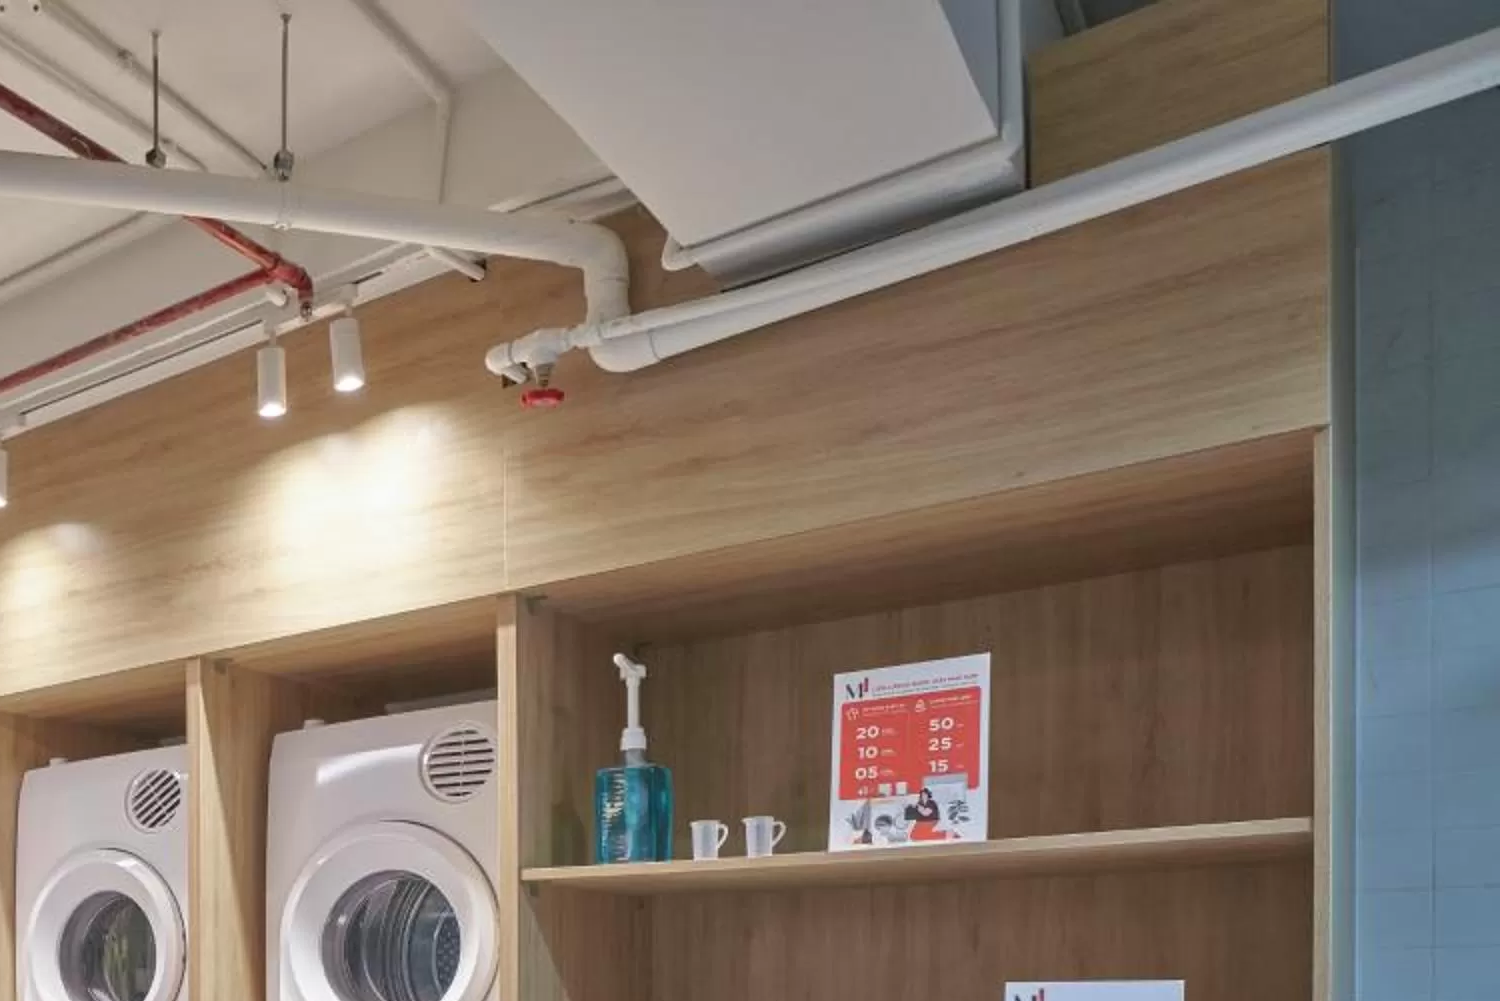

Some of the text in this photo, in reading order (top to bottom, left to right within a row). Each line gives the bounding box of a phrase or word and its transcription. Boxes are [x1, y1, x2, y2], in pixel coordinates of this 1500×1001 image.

[928, 717, 954, 732] 50
[856, 725, 879, 740] 20
[928, 737, 952, 751] 25
[858, 746, 878, 760] 10
[855, 766, 878, 780] 05
[929, 759, 949, 773] 15
